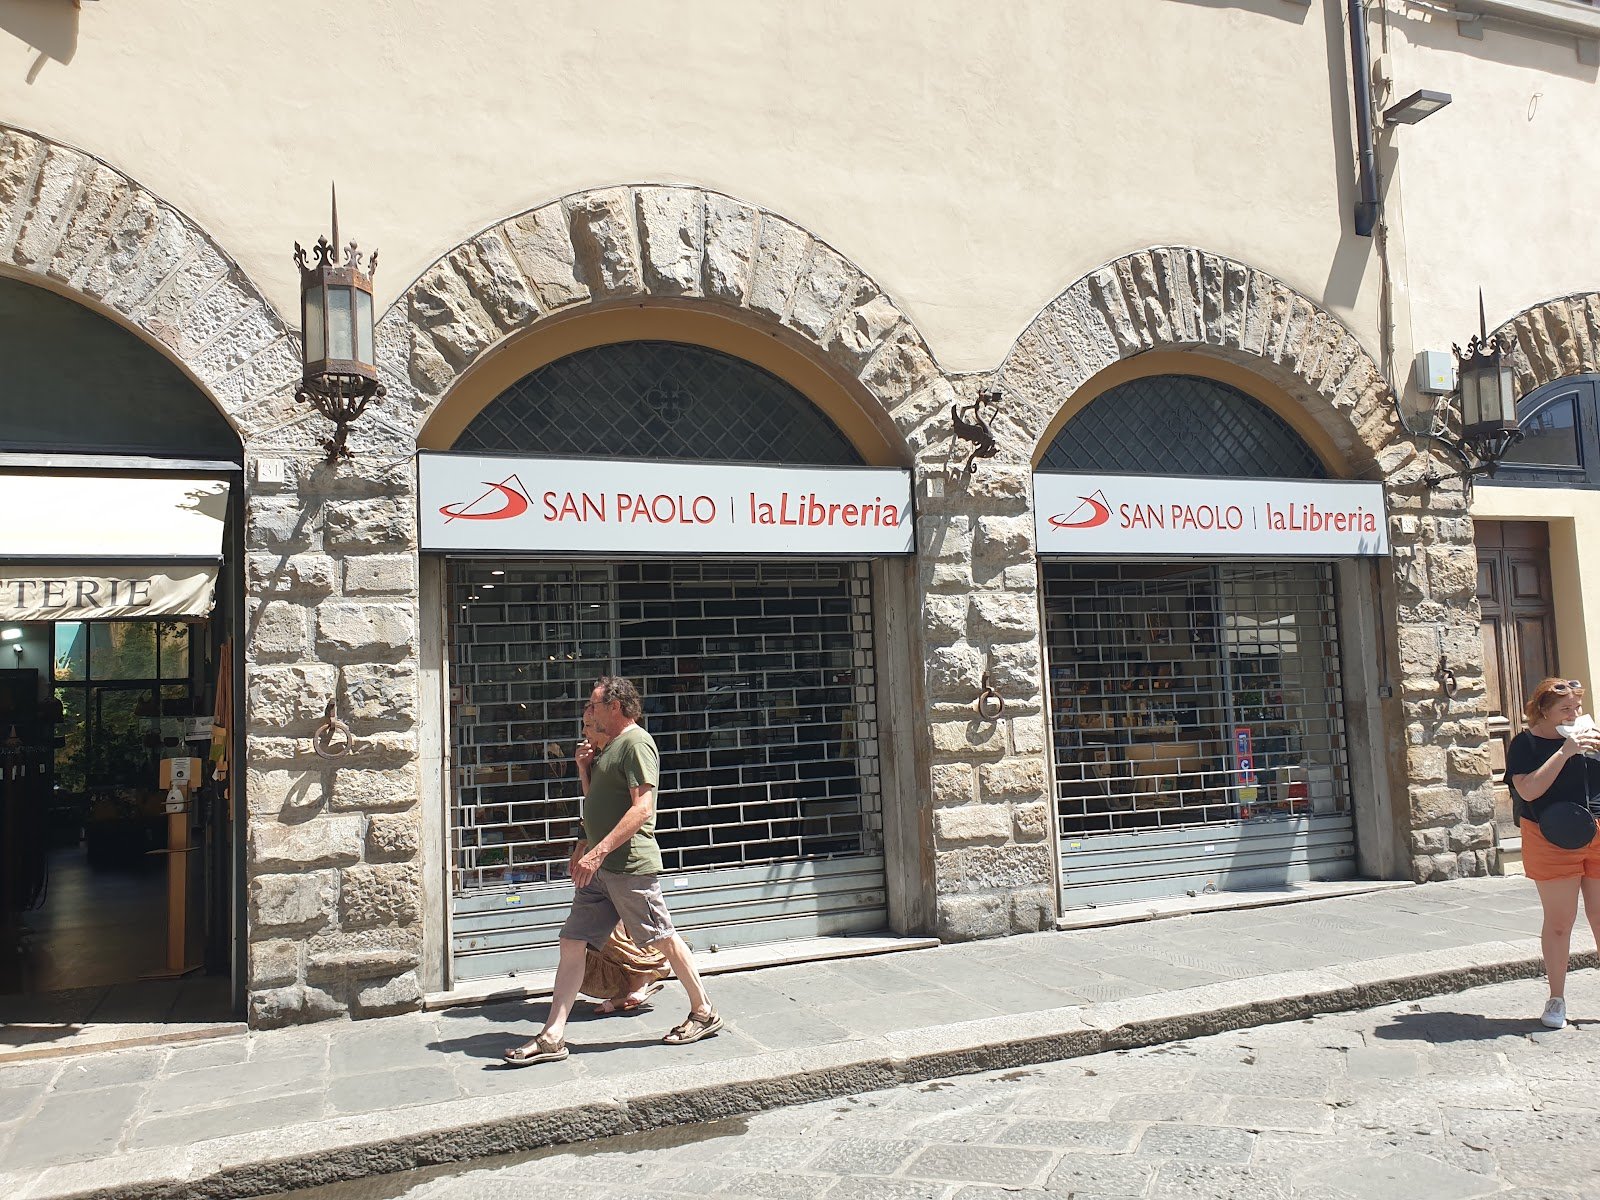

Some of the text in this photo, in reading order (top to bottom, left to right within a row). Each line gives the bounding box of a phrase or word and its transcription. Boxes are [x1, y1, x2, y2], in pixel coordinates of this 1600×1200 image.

[261, 463, 278, 478] 31
[543, 491, 900, 528] SAN PAOLO laLibreria
[1119, 502, 1376, 533] SAN PAOLO laLibreria
[0, 579, 153, 609] TERIE
